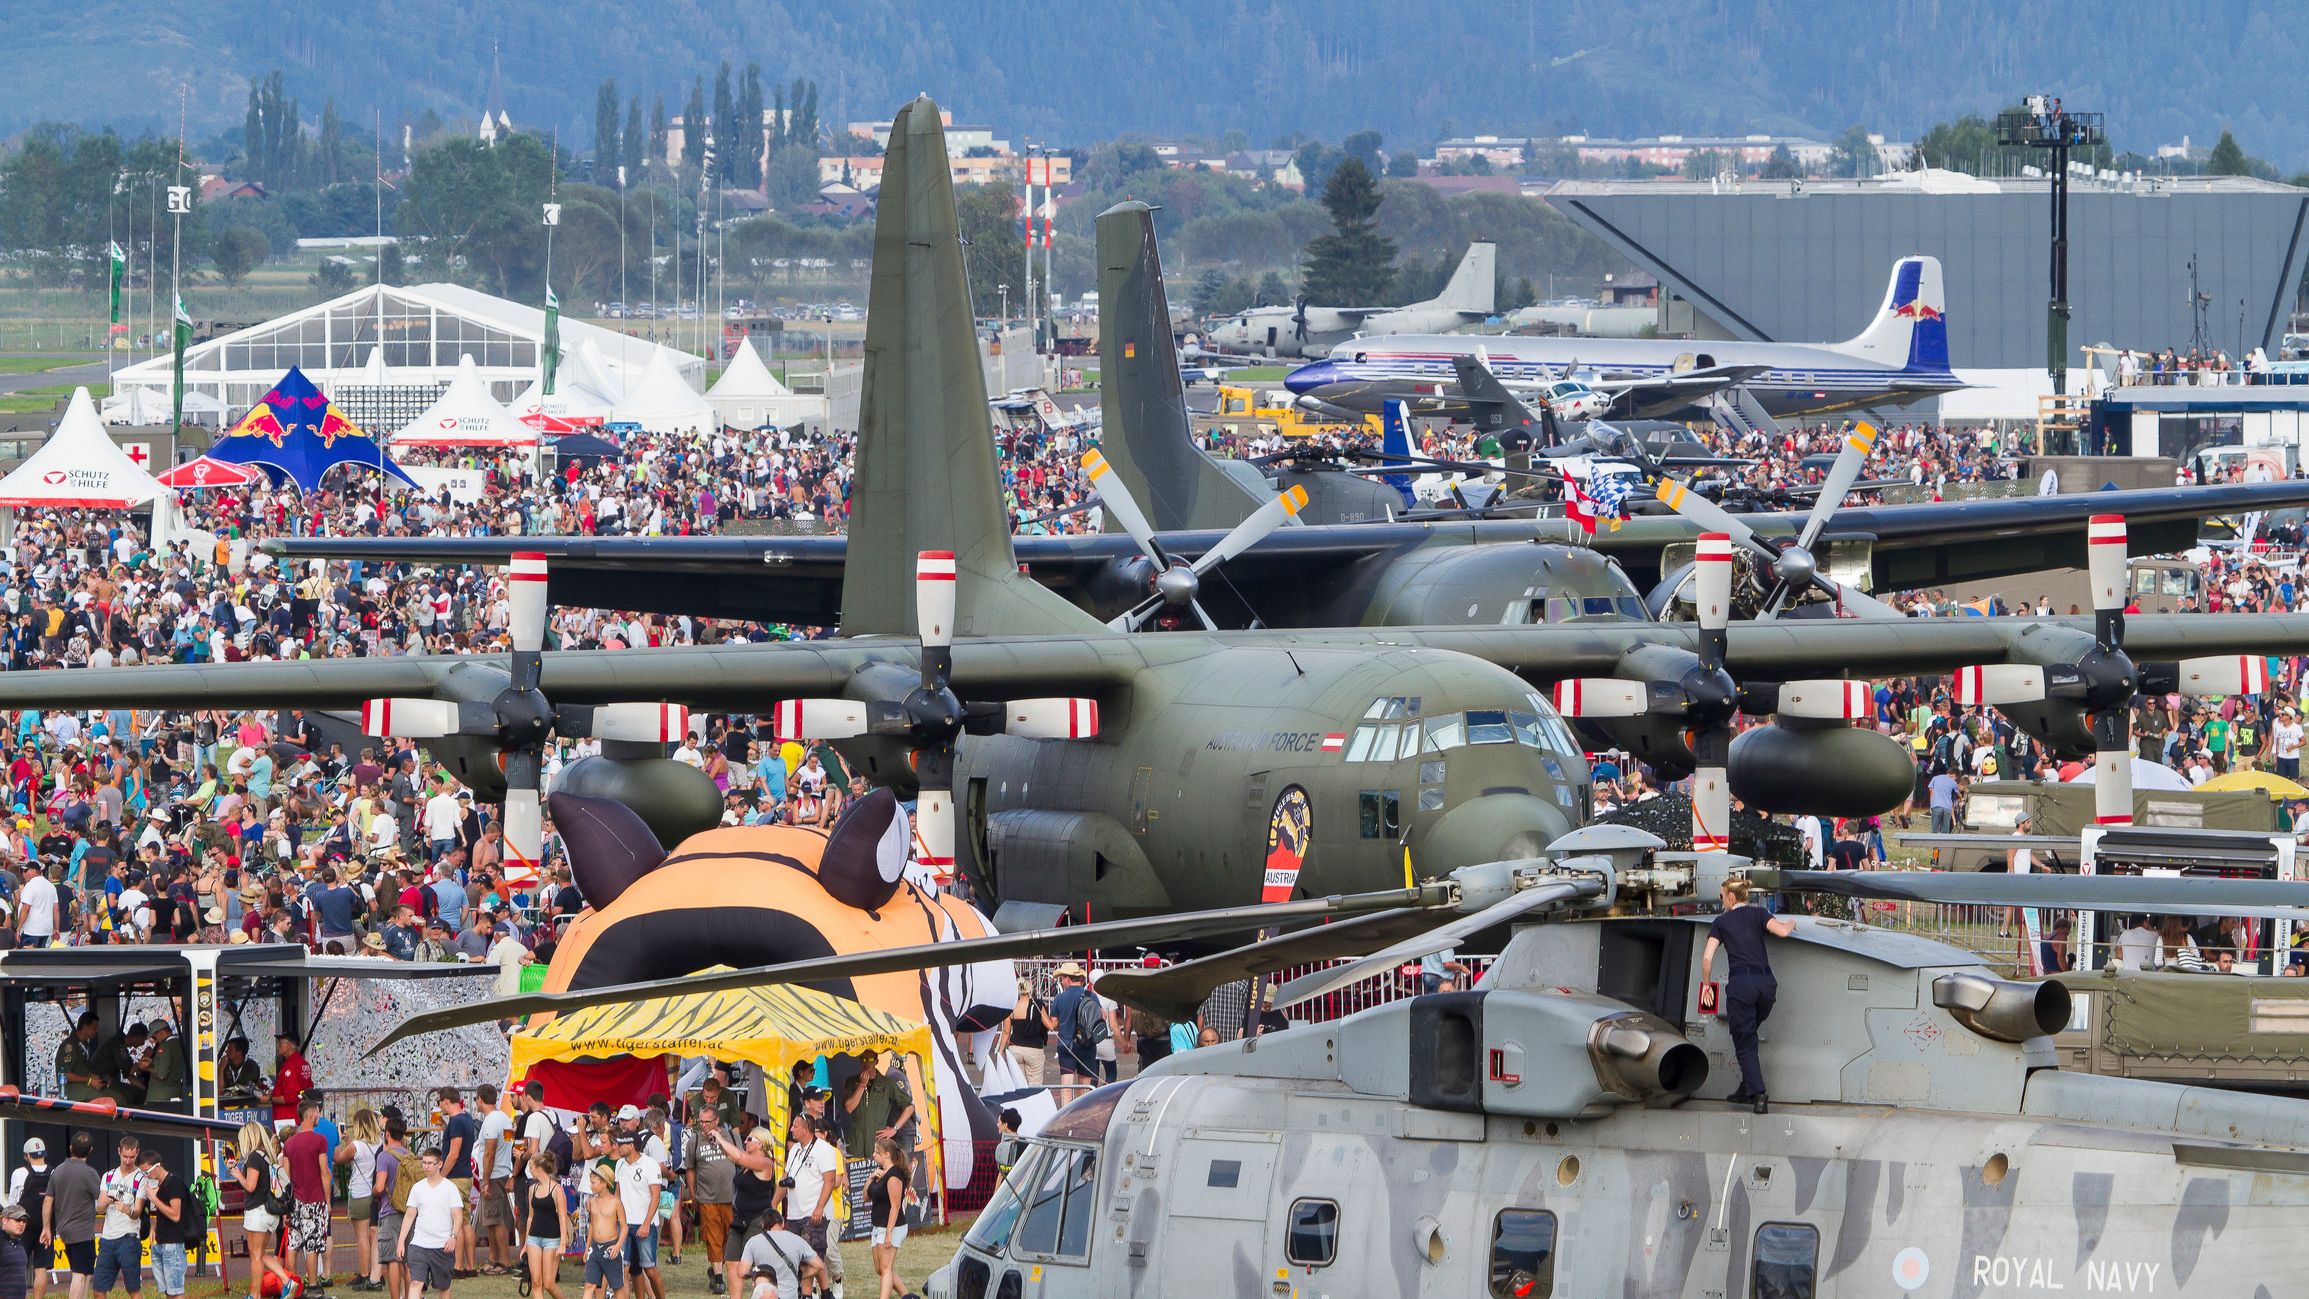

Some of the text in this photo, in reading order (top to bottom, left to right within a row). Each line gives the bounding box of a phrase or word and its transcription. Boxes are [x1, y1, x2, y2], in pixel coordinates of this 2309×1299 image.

[1044, 402, 1052, 413] B
[68, 470, 109, 480] SCHUTZ
[78, 479, 109, 488] HILFE
[1271, 732, 1320, 752] FORCE
[1265, 872, 1296, 884] AUSTRIA
[224, 1112, 243, 1123] TIGER
[261, 1109, 268, 1120] IN
[850, 1161, 866, 1169] SAAB
[633, 1167, 642, 1181] 8
[1973, 1255, 2160, 1293] ROYAL NAVY
